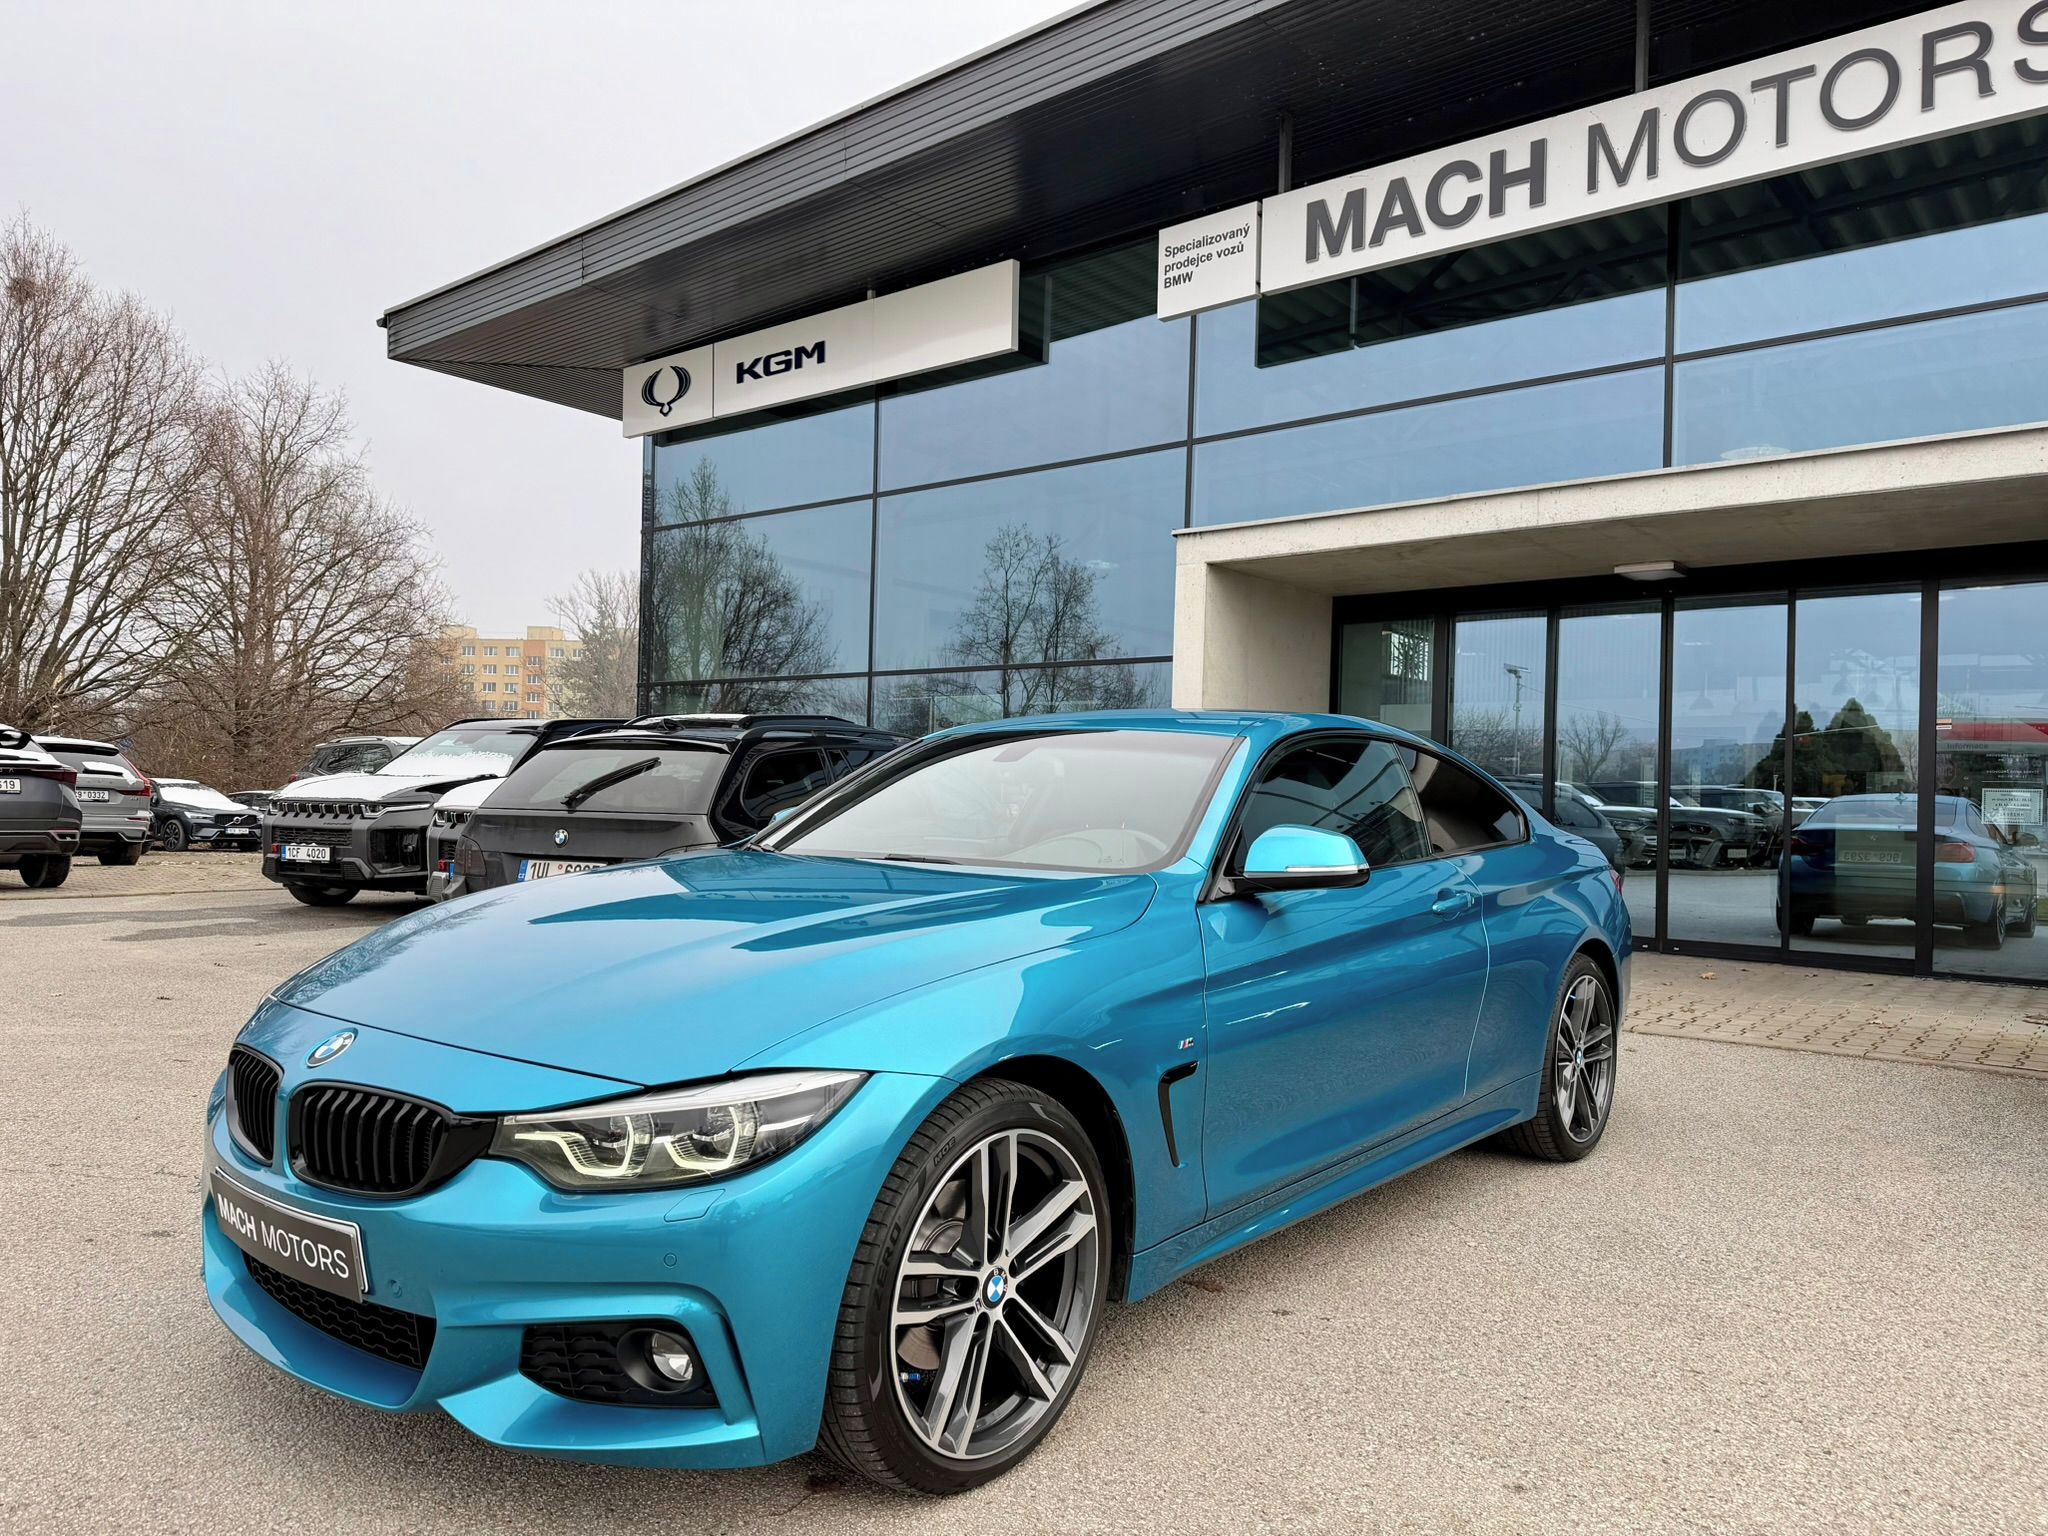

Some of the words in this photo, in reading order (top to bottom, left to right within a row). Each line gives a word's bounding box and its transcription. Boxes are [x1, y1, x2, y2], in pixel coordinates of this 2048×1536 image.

[1306, 138, 1548, 264] MACH
[1164, 222, 1250, 258] Specializovaný
[1164, 251, 1213, 276] prodejce
[1216, 241, 1244, 259] vozů
[1164, 270, 1194, 289] BMW
[736, 340, 826, 385] KGM
[87, 791, 106, 799] 0332
[287, 847, 301, 858] 1CF
[306, 848, 327, 859] 4020
[217, 1193, 258, 1242] MACH
[260, 1220, 349, 1279] MOTORS
